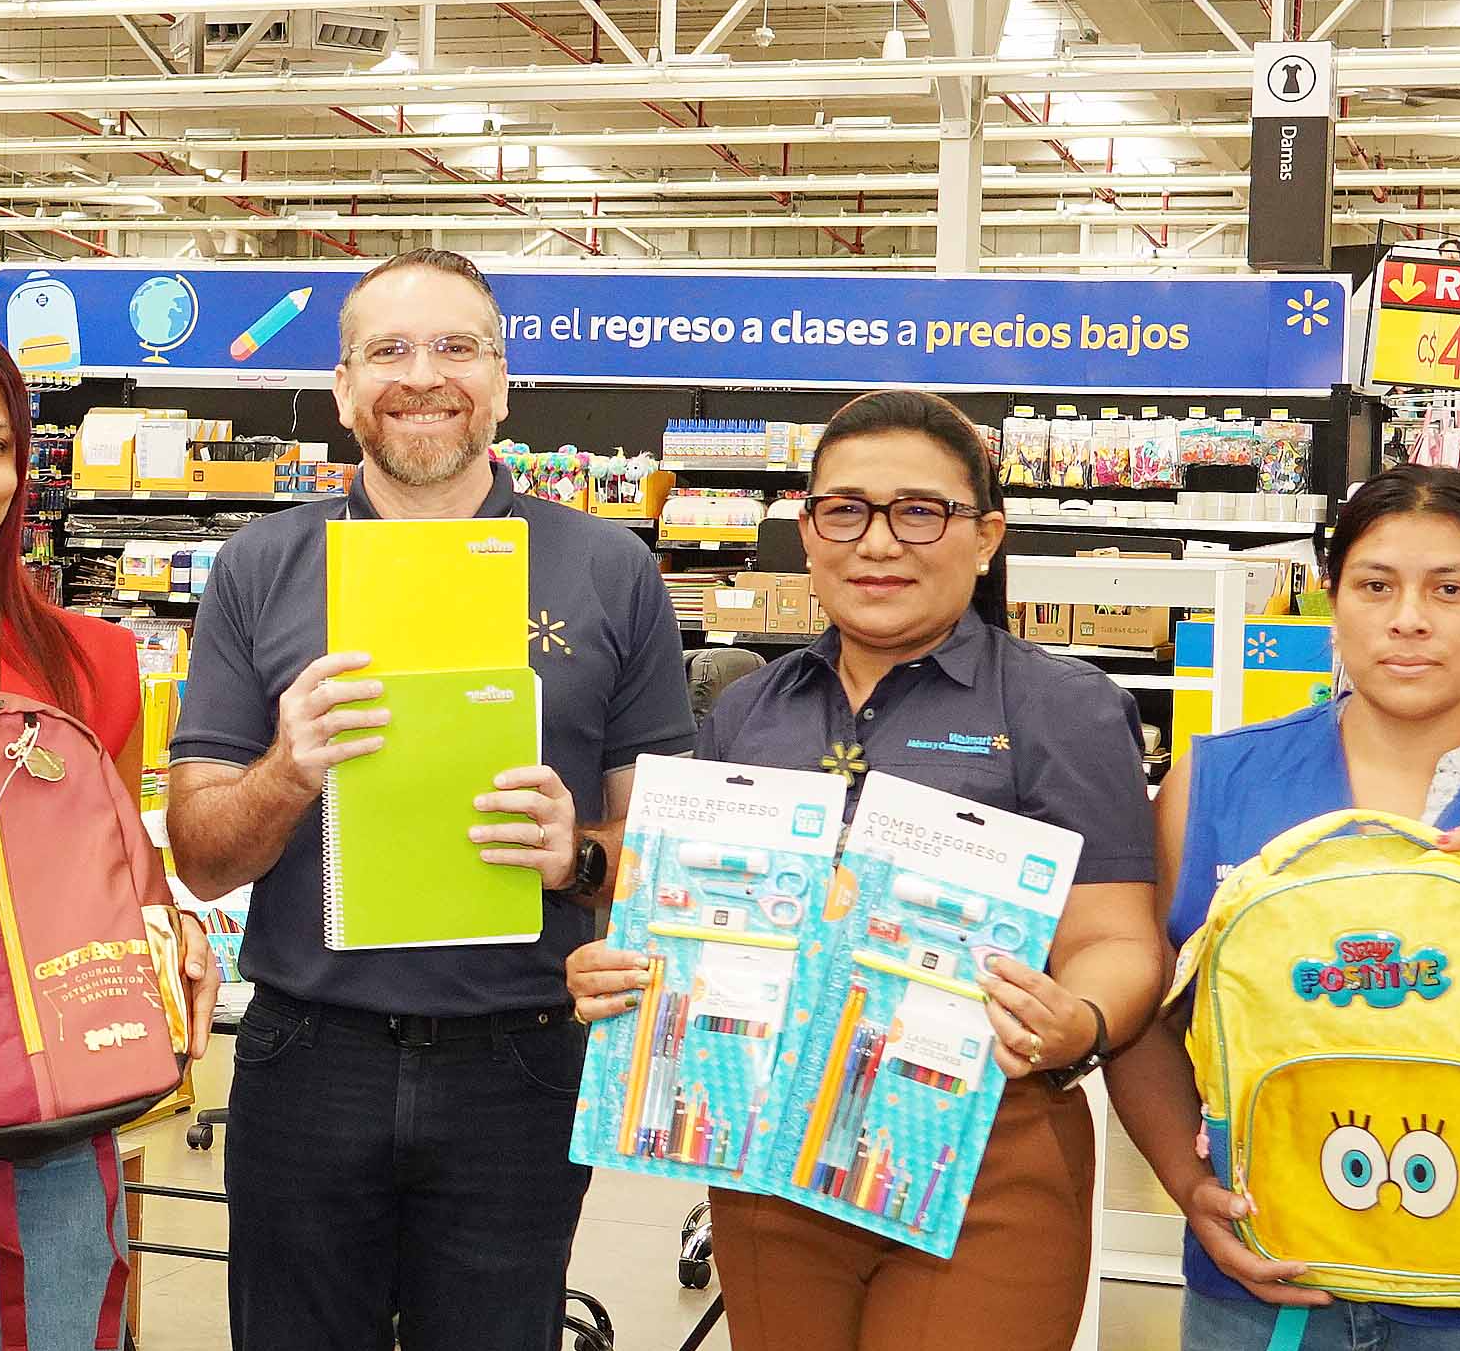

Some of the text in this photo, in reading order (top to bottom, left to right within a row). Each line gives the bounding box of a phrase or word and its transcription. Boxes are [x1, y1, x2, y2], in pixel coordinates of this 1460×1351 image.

[1280, 125, 1297, 181] Damas
[499, 309, 1189, 355] ra el regreso a clases a precios bajos
[1416, 330, 1437, 370] C$
[643, 792, 778, 817] COMBO REGRESO
[658, 806, 716, 824] CLASES
[868, 812, 1008, 864] COMBO REGRESO
[881, 830, 943, 858] CLASES
